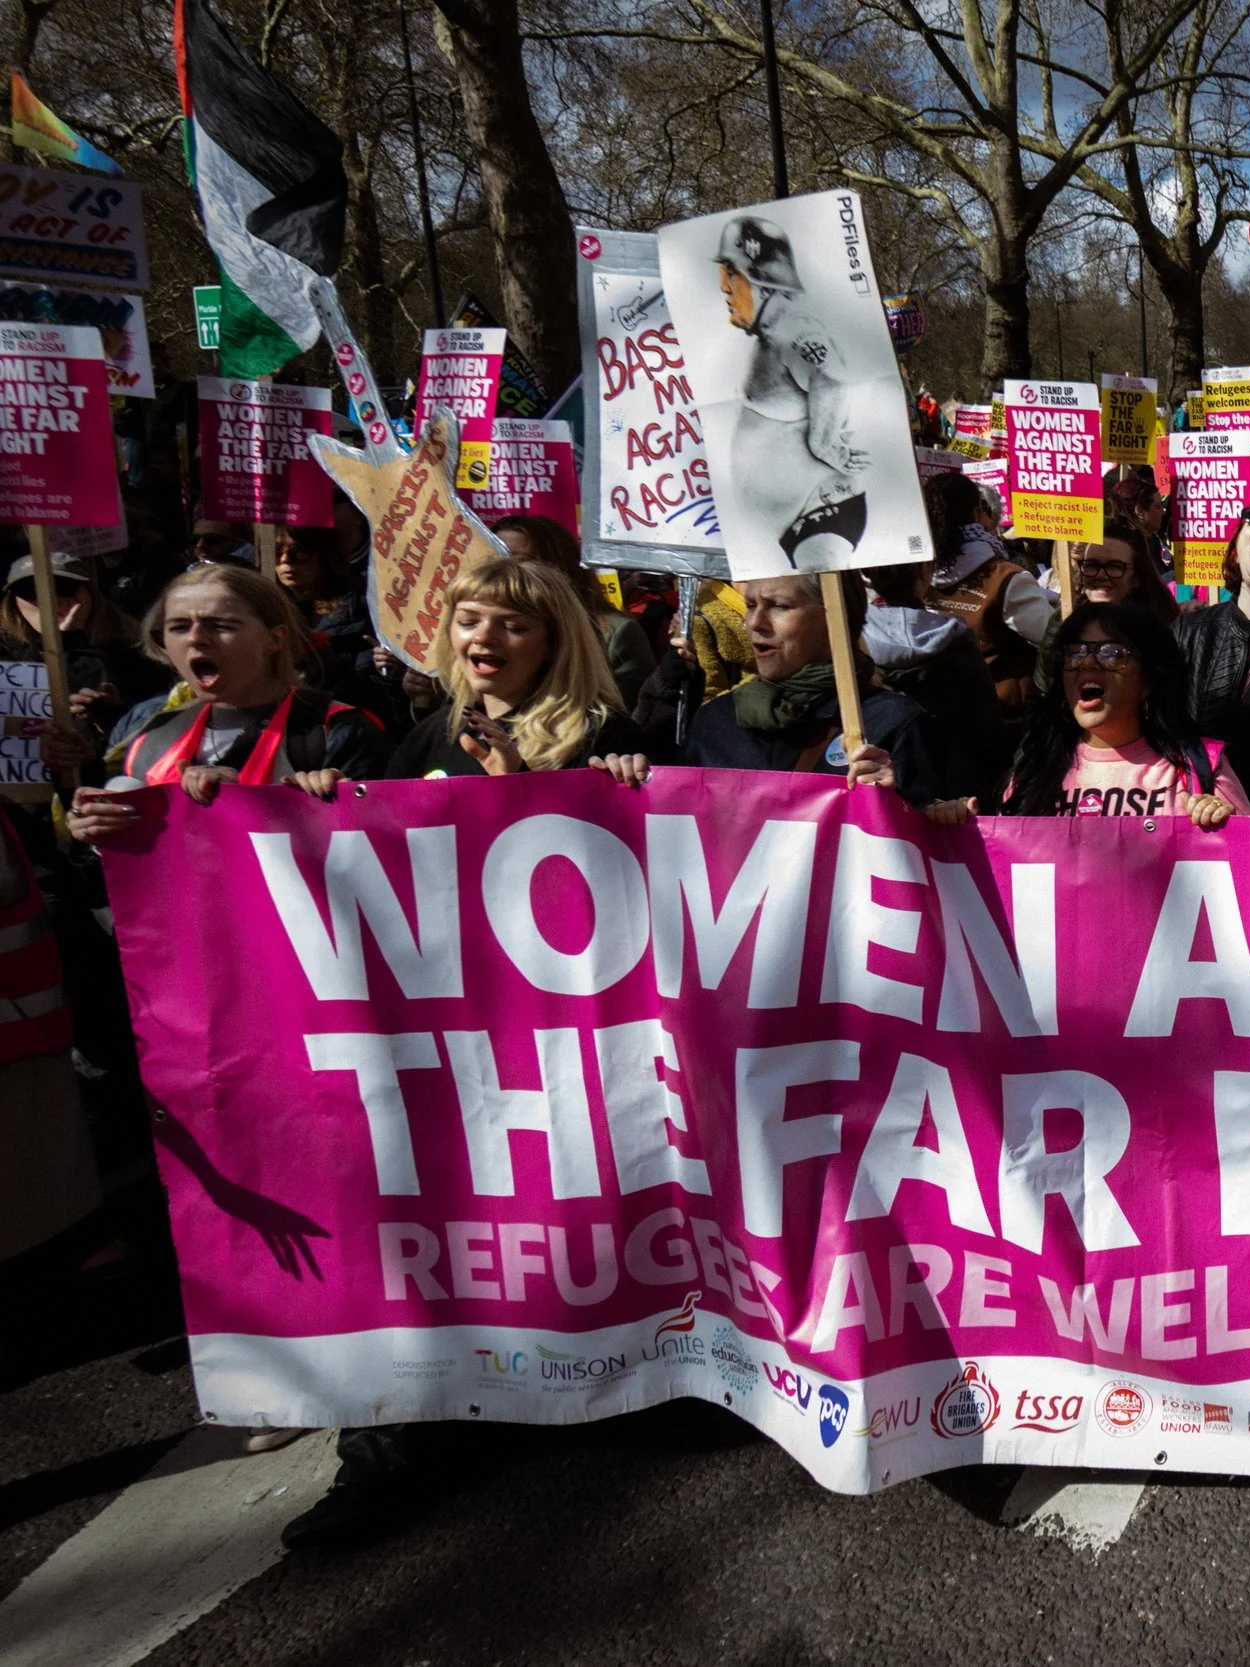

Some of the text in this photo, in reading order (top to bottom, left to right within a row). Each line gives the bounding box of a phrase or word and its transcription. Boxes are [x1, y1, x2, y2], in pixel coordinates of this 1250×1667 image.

[67, 186, 123, 218] IS
[8, 213, 132, 244] ACT OF
[837, 195, 861, 269] PDFiles
[425, 358, 488, 378] WOMEN
[421, 379, 494, 397] AGAINST
[1110, 390, 1143, 407] STOP
[1040, 395, 1078, 406] TO RACISM
[1207, 397, 1250, 408] welcome
[20, 408, 80, 432] FAR
[216, 403, 303, 427] WOMEN
[1011, 410, 1085, 432] WOMEN
[1111, 406, 1134, 421] THE
[1110, 419, 1132, 434] FAR
[217, 438, 310, 461] THE FAR
[1014, 431, 1095, 454] AGAINST
[1109, 434, 1149, 450] RIGHT
[218, 455, 288, 476] RIGHT
[1015, 451, 1053, 472] THE
[1055, 454, 1092, 474] FAR
[1017, 471, 1075, 493] RIGHT
[471, 493, 533, 509] RIGHT
[1024, 512, 1083, 525] Refugees are
[1025, 523, 1083, 536] not to blame
[385, 489, 447, 621] AGAINST
[248, 812, 1058, 1037] WOMEN
[303, 1018, 713, 1201] THE
[734, 1038, 1141, 1254] FAR
[377, 1208, 788, 1346] REFUGEES
[811, 1244, 1017, 1355] ARE
[474, 1348, 529, 1377] TUC
[541, 1353, 627, 1381] UNISON
[678, 1357, 706, 1366] UNION
[711, 1347, 759, 1374] education
[959, 1390, 976, 1402] FIRE
[1015, 1389, 1084, 1421] tssa
[1162, 1399, 1201, 1412] FOOD
[820, 1397, 847, 1432] pcs
[871, 1396, 921, 1439] CWU
[947, 1402, 985, 1418] BRIGADES
[952, 1415, 977, 1430] UNION
[1160, 1422, 1201, 1434] UNION
